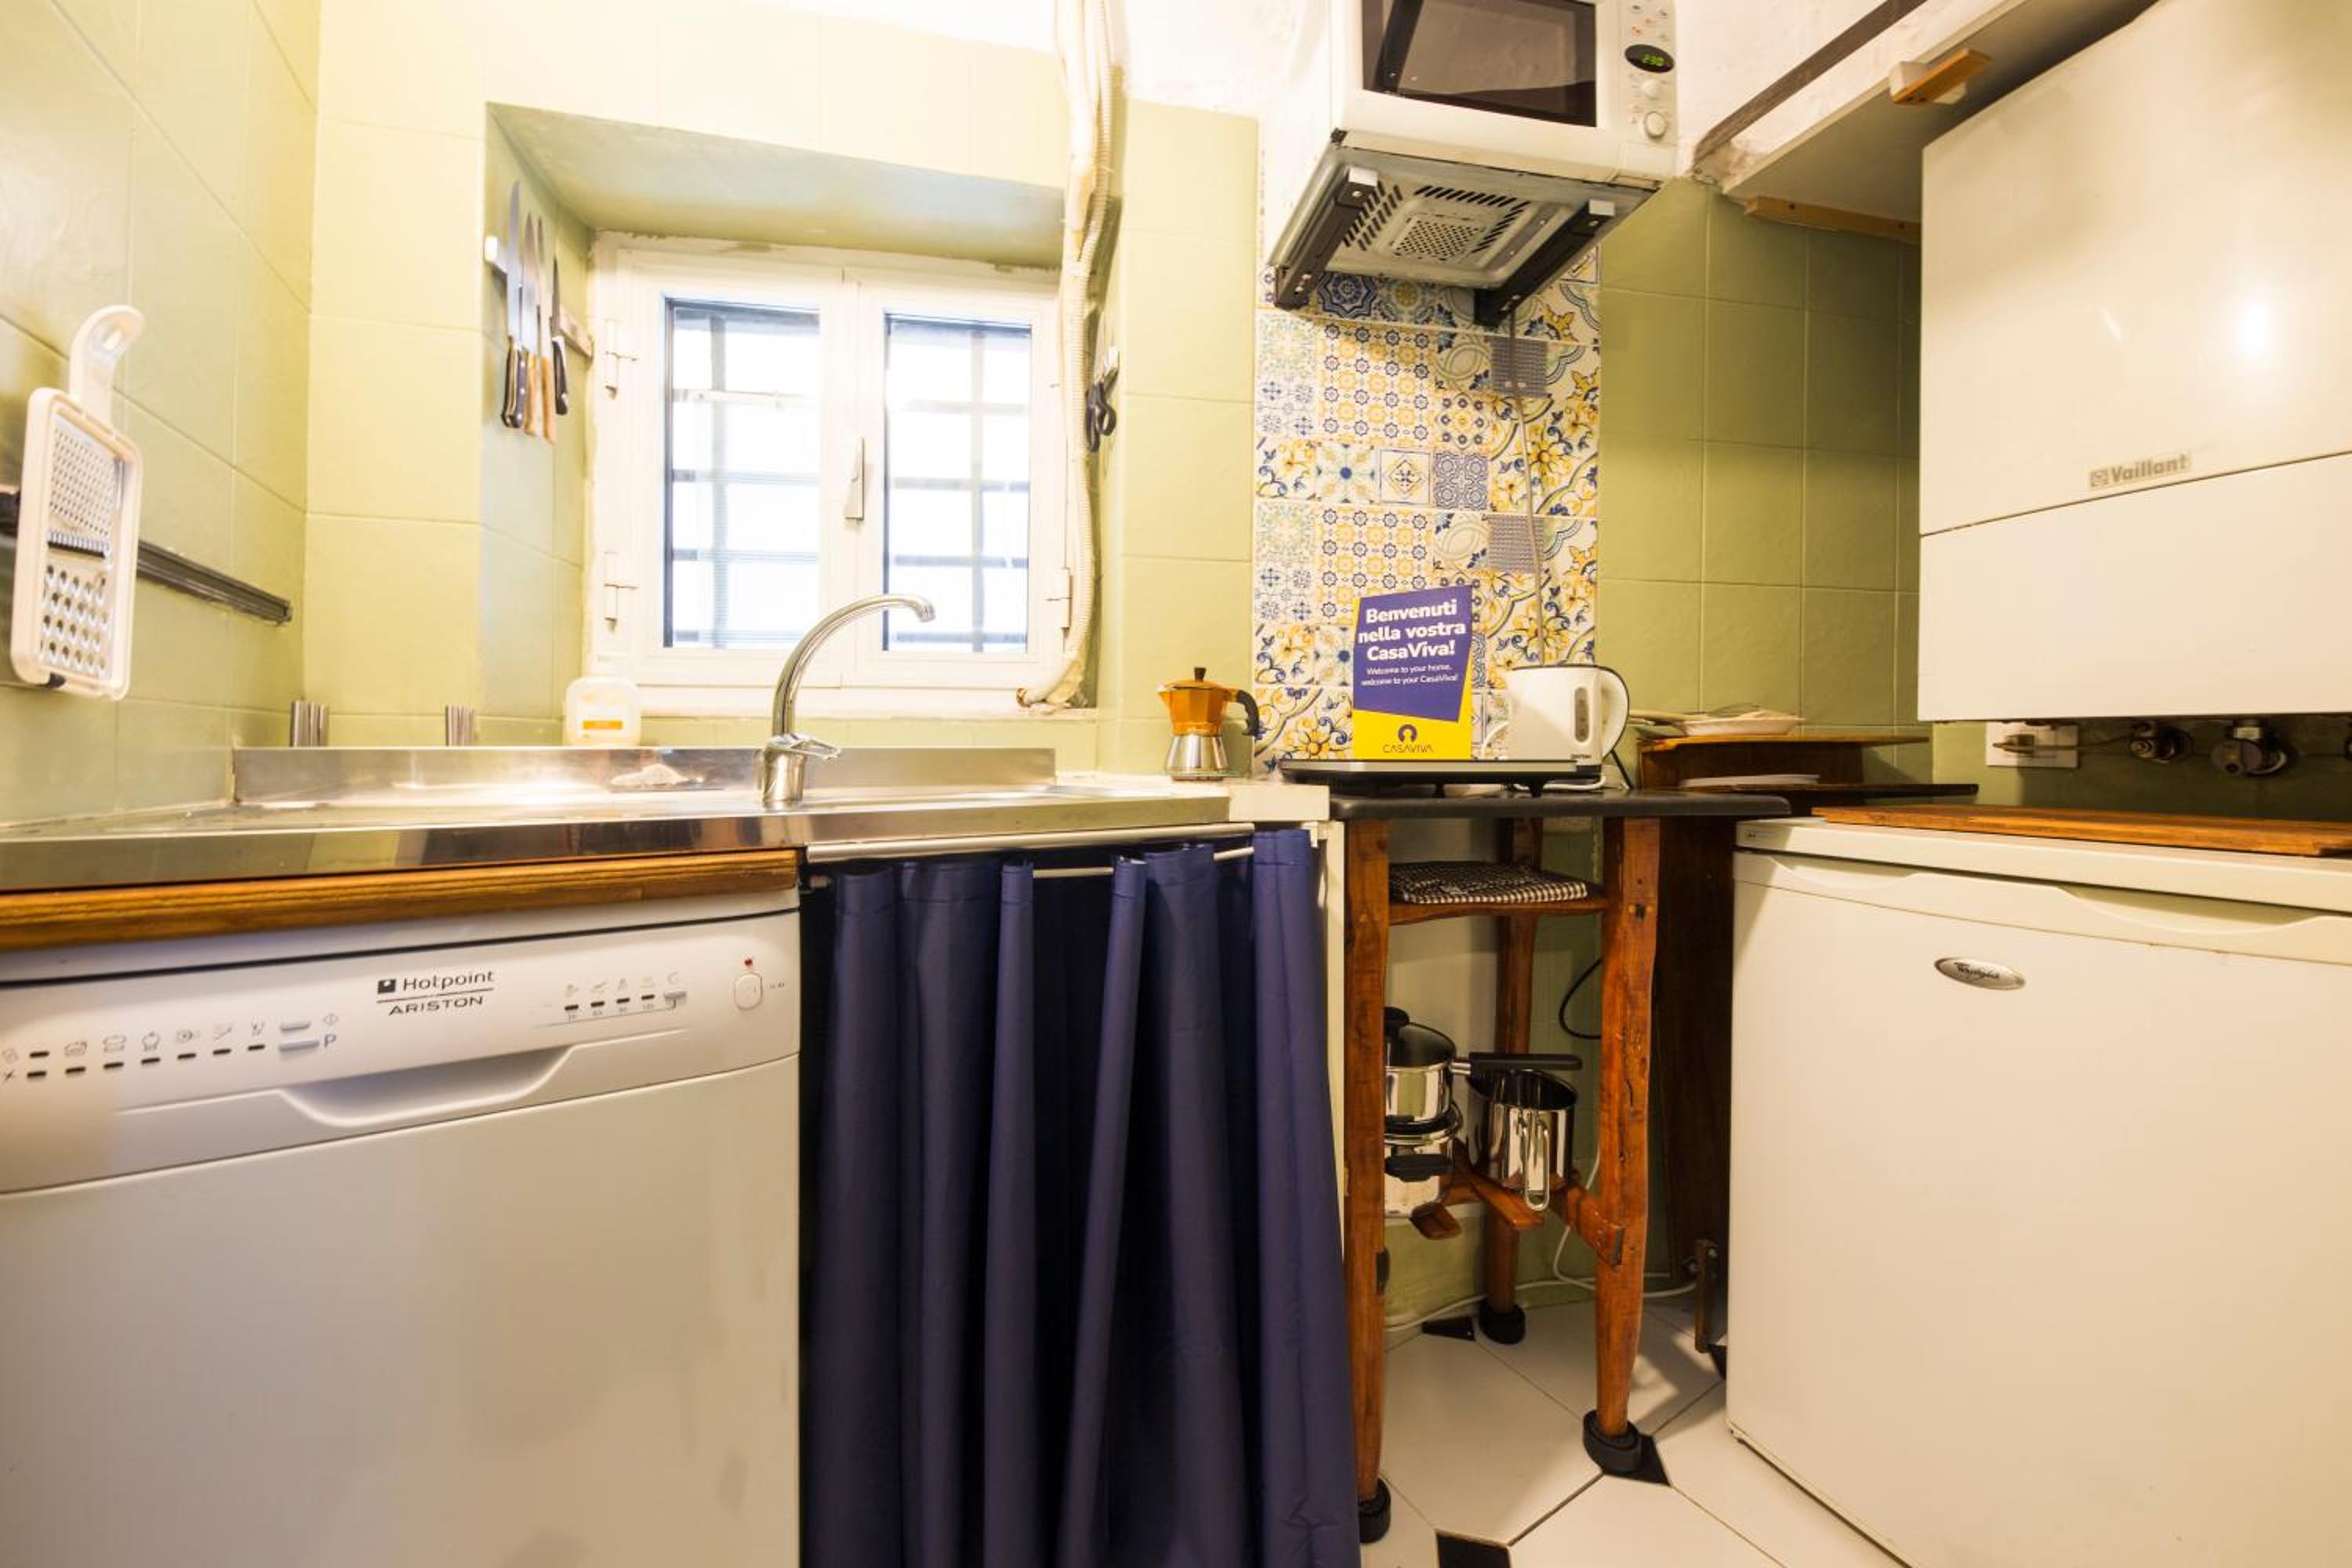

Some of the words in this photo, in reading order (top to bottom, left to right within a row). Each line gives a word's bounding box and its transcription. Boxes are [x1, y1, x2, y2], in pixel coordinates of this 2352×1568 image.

[2111, 453, 2187, 483] Vaillant
[1365, 598, 1457, 624] Benvenuti
[1358, 626, 1401, 644] nella
[1405, 622, 1467, 639] vostra
[1367, 640, 1456, 661] CasaViva!
[1367, 666, 1399, 675] Welcome
[1410, 665, 1426, 674] your
[1393, 676, 1401, 684] to
[1403, 676, 1419, 684] your
[1382, 744, 1435, 753] CASAVIVA
[403, 970, 495, 991] Hotpoint
[389, 996, 484, 1016] ARISTON
[324, 1033, 337, 1050] P
